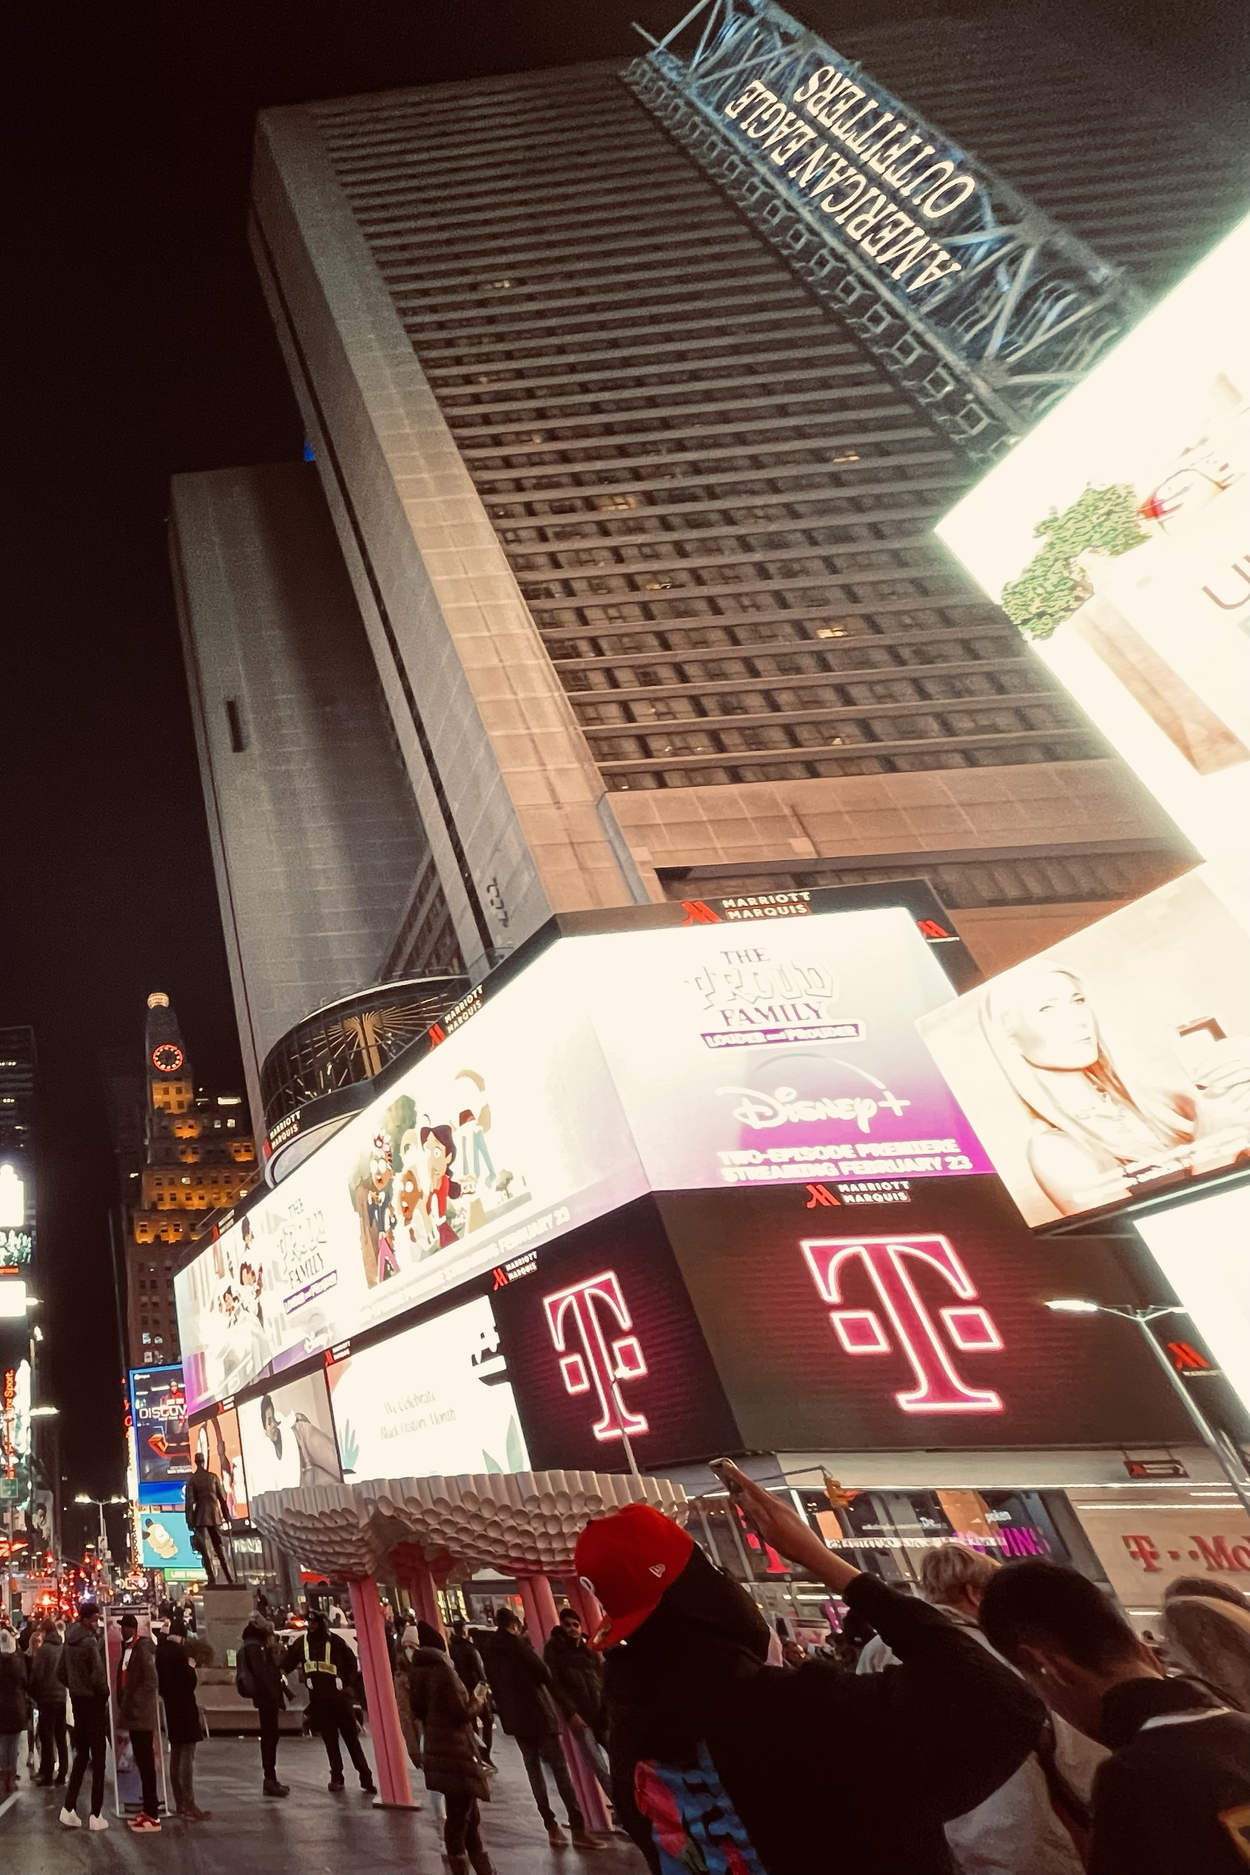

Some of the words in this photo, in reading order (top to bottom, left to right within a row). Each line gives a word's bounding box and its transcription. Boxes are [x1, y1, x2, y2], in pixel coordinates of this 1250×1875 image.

[724, 79, 819, 166] EAGLE
[793, 65, 976, 219] OUTFITTERS
[787, 143, 962, 293] AMERICAN
[721, 892, 811, 909] MARRIOTT
[727, 904, 811, 920] MARQUIS
[720, 947, 771, 966] THE
[444, 984, 485, 1025] MARRIOTT
[718, 1001, 825, 1028] FAMILY
[447, 1000, 483, 1035] MARQUIS
[269, 1111, 301, 1140] MARRIOTT
[271, 1124, 299, 1150] MARQUIS
[717, 1144, 858, 1166] TWO-EPISODE
[839, 1157, 944, 1178] FEBRUARY
[945, 1155, 973, 1171] 23
[838, 1180, 911, 1194] MARRIOTT
[842, 1190, 911, 1204] MARQUIS
[505, 1251, 538, 1271] MARRIOTT
[508, 1262, 537, 1281] MARQUIS
